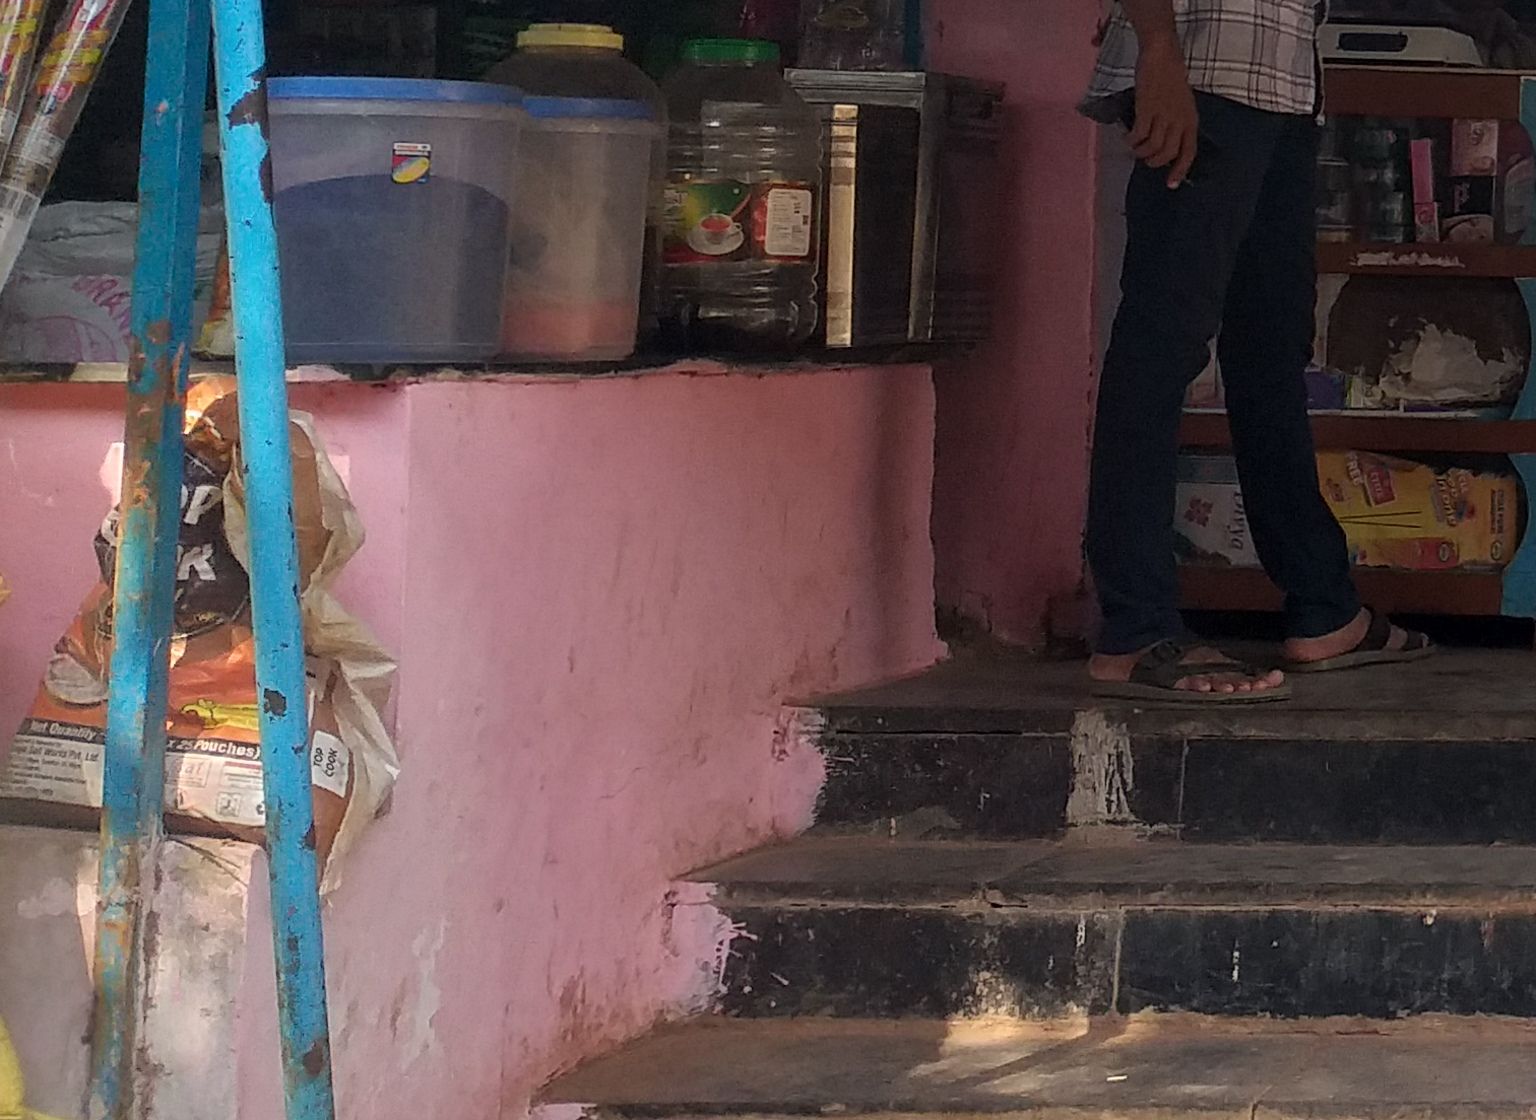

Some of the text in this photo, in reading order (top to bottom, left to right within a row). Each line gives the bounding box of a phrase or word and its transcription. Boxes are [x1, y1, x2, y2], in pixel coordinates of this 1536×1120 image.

[49, 721, 97, 742] Quantity
[194, 738, 261, 761] Pouches)
[313, 747, 324, 768] TOP
[323, 746, 339, 778] COOK
